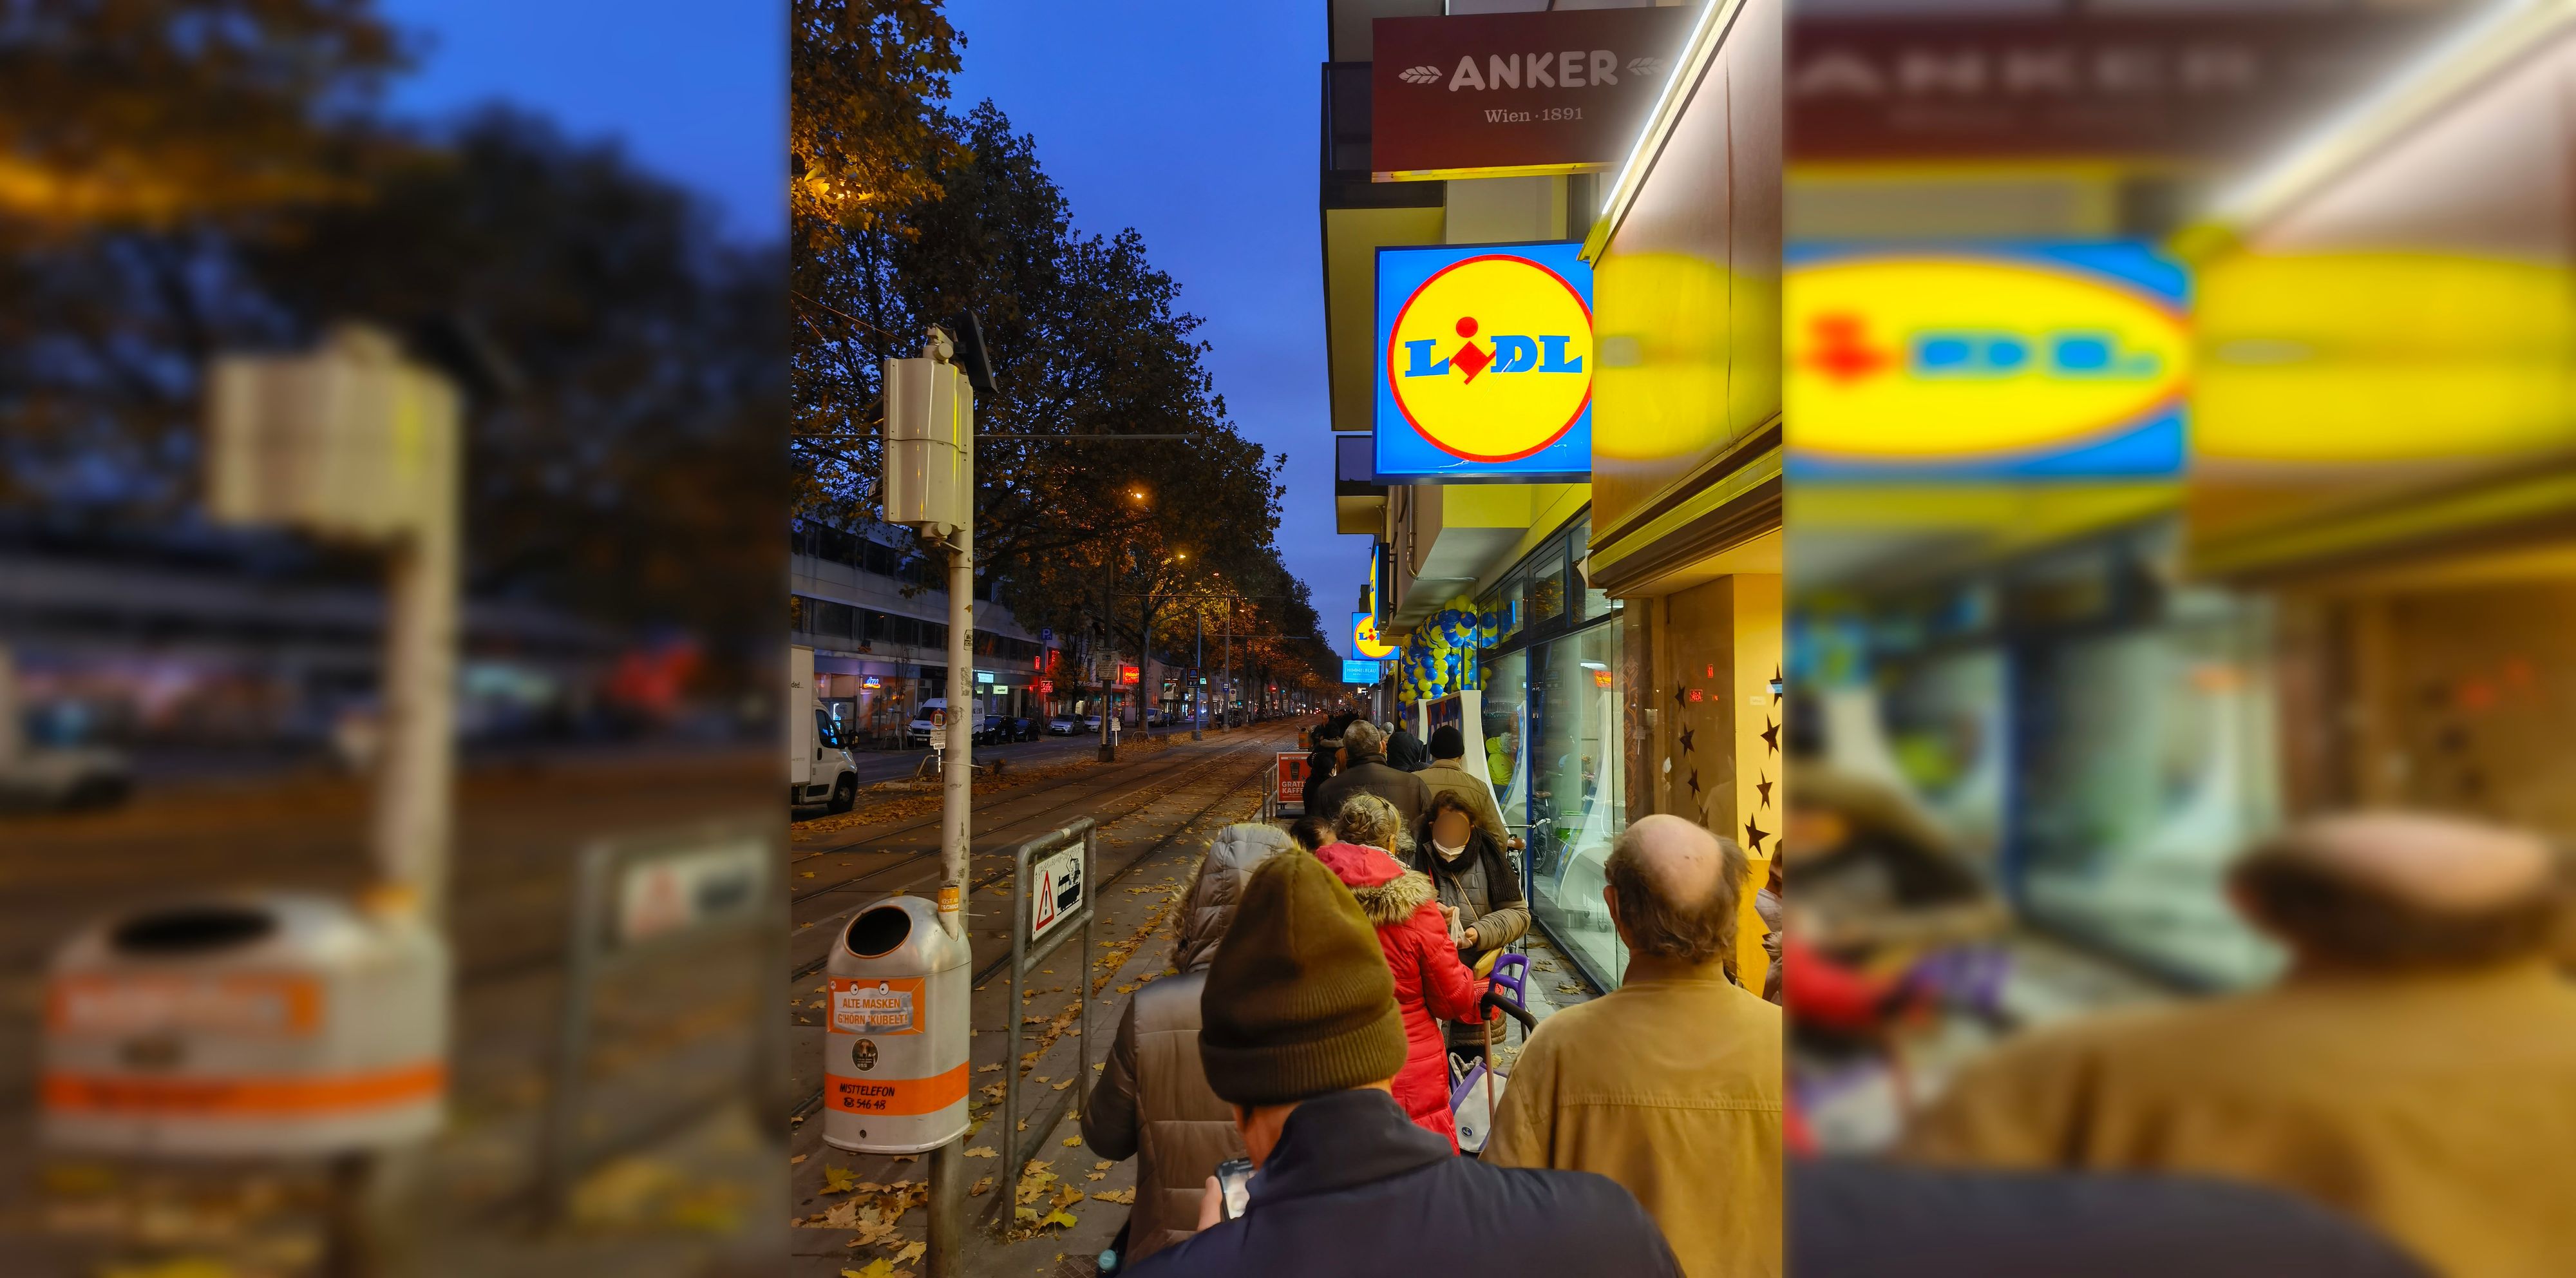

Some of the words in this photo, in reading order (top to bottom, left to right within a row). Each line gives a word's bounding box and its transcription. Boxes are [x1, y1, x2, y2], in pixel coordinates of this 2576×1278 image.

[1449, 50, 1618, 91] ANKER
[1484, 109, 1531, 123] Wien
[1542, 108, 1584, 122] 1891
[842, 998, 860, 1009] ALTE
[863, 998, 901, 1009] MASKEN
[839, 1083, 895, 1097] MISTTELEFON
[857, 1098, 871, 1109] 546
[873, 1100, 886, 1110] 48
